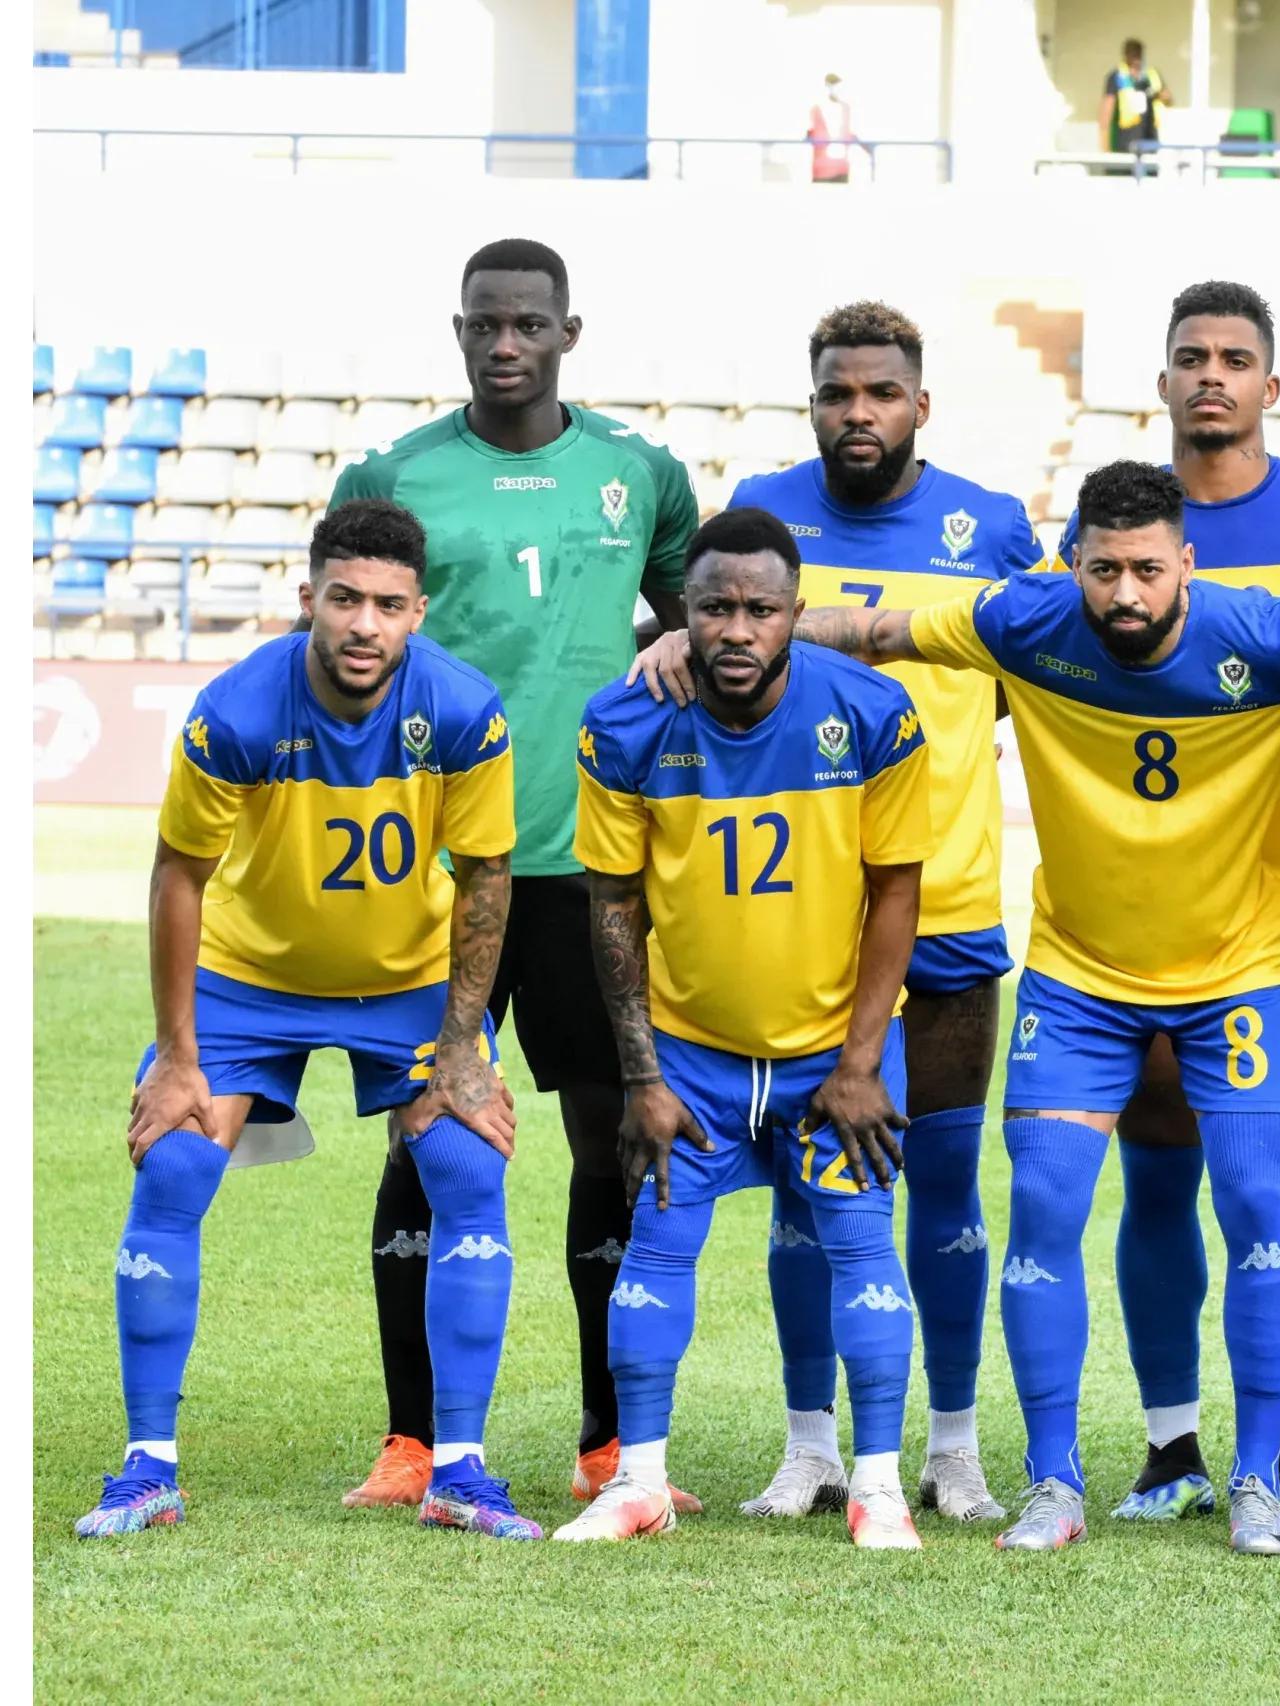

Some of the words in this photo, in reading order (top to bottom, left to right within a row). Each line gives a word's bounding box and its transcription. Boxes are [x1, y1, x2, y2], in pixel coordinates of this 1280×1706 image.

[494, 477, 556, 491] Kappa
[517, 546, 542, 597] 1
[930, 557, 976, 572] FEGAFOOT
[1036, 653, 1097, 681] Kappa
[1213, 703, 1258, 712] FEGAFOOT
[814, 770, 859, 782] FEGAFOOT
[1133, 731, 1180, 801] 8
[321, 811, 415, 890] 20
[706, 811, 793, 895] 12
[1224, 1006, 1269, 1089] 8
